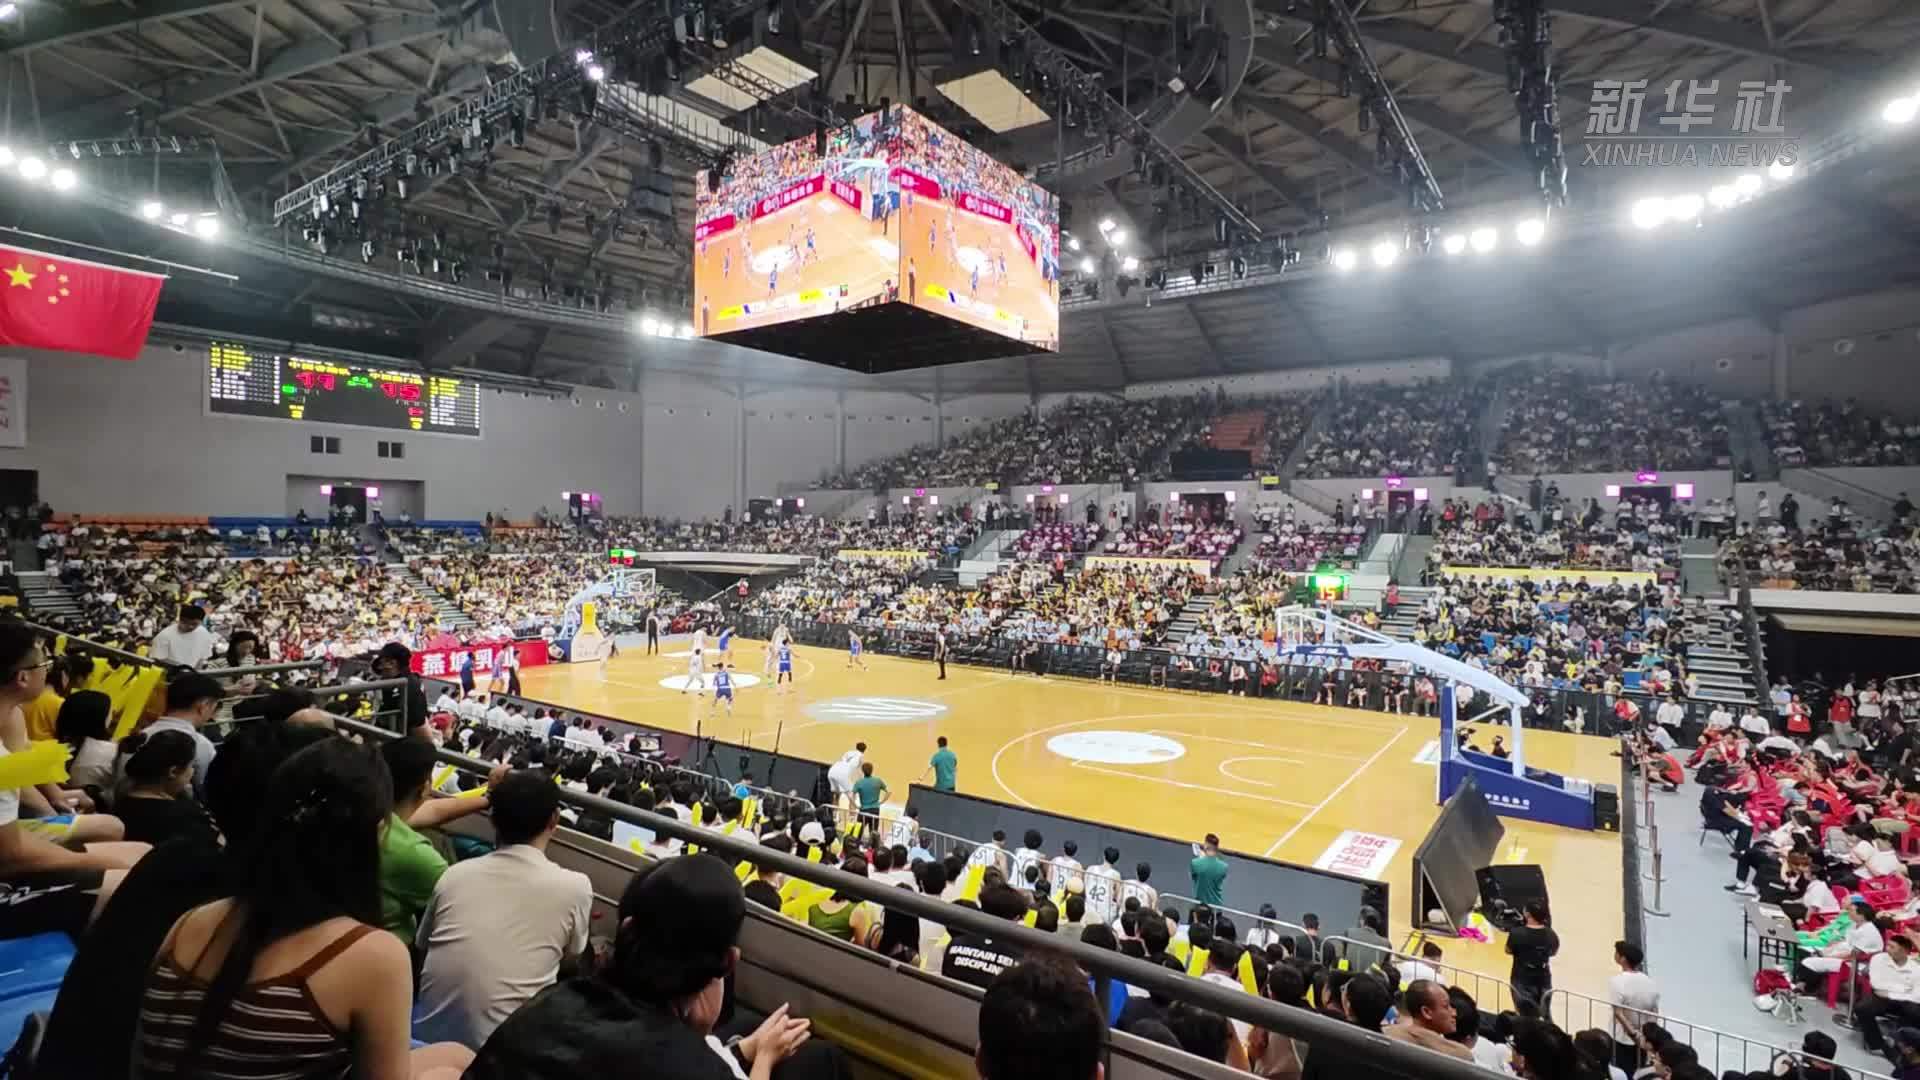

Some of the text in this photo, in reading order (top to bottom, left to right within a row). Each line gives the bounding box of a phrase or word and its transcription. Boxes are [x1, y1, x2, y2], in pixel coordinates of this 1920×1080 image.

[1089, 884, 1106, 902] 42
[949, 945, 998, 962] MAINTAIN
[954, 955, 1004, 977] DISCIPLIN
